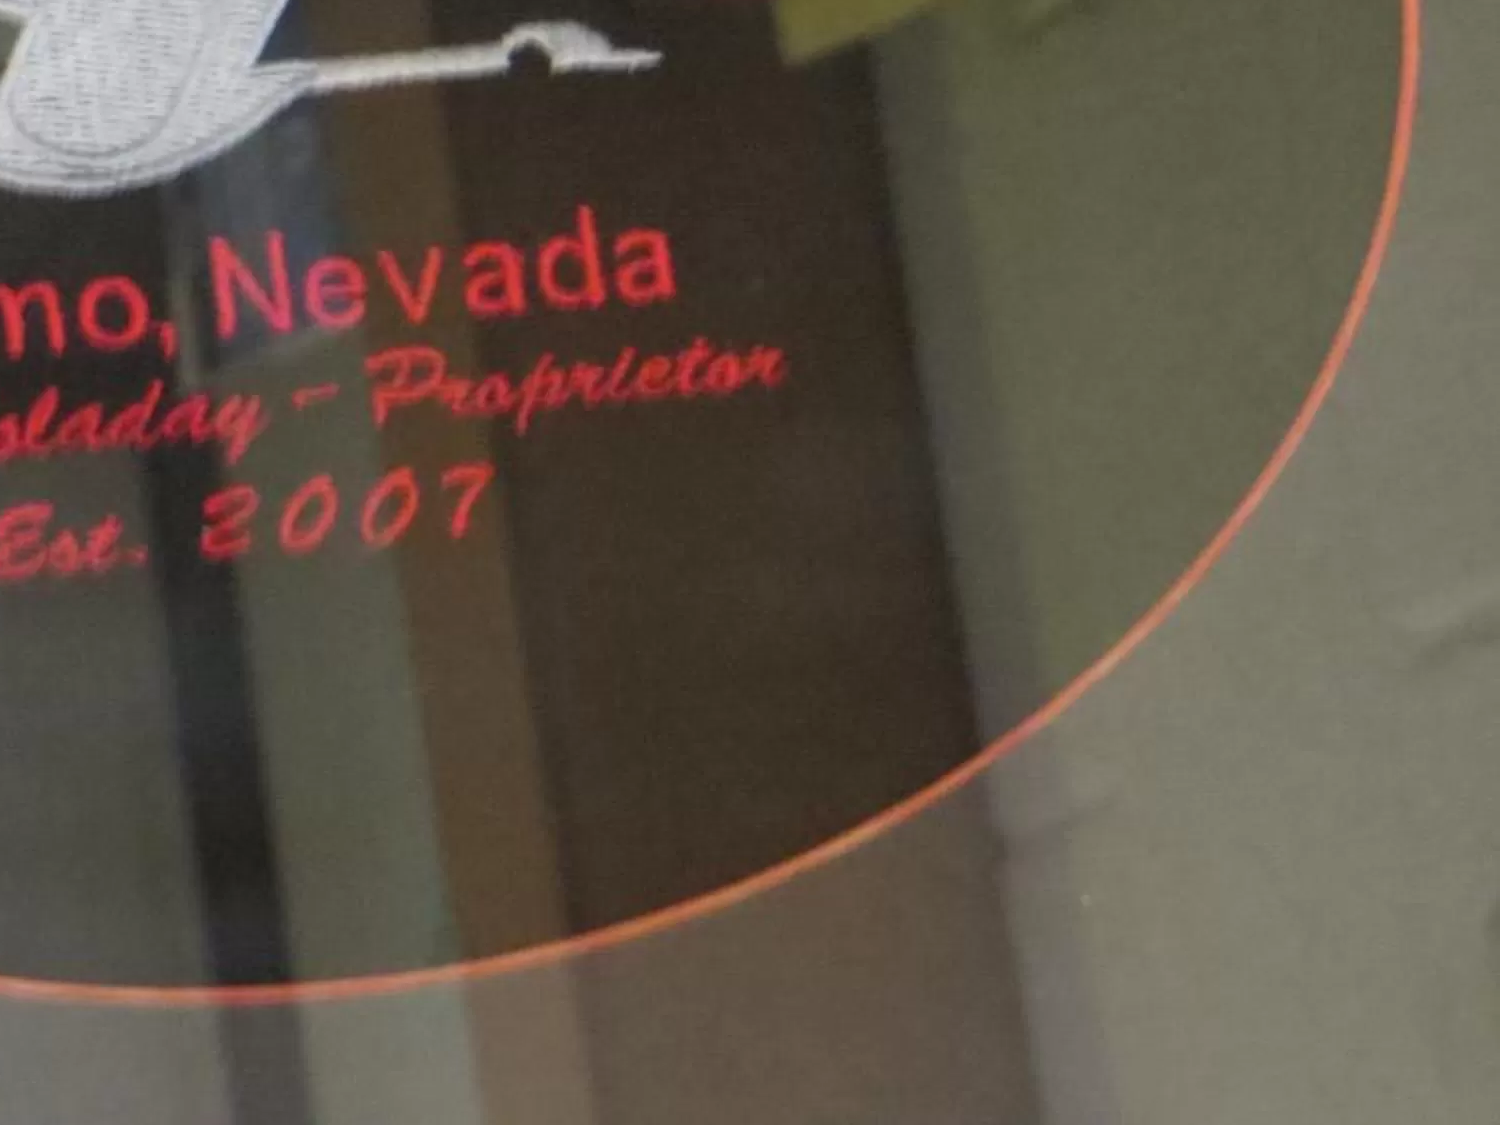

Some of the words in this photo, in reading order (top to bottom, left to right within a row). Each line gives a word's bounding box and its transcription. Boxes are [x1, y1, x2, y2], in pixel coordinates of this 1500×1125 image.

[207, 202, 679, 341] Nevada
[363, 334, 785, 438] Proprietor
[199, 460, 497, 562] 2007
